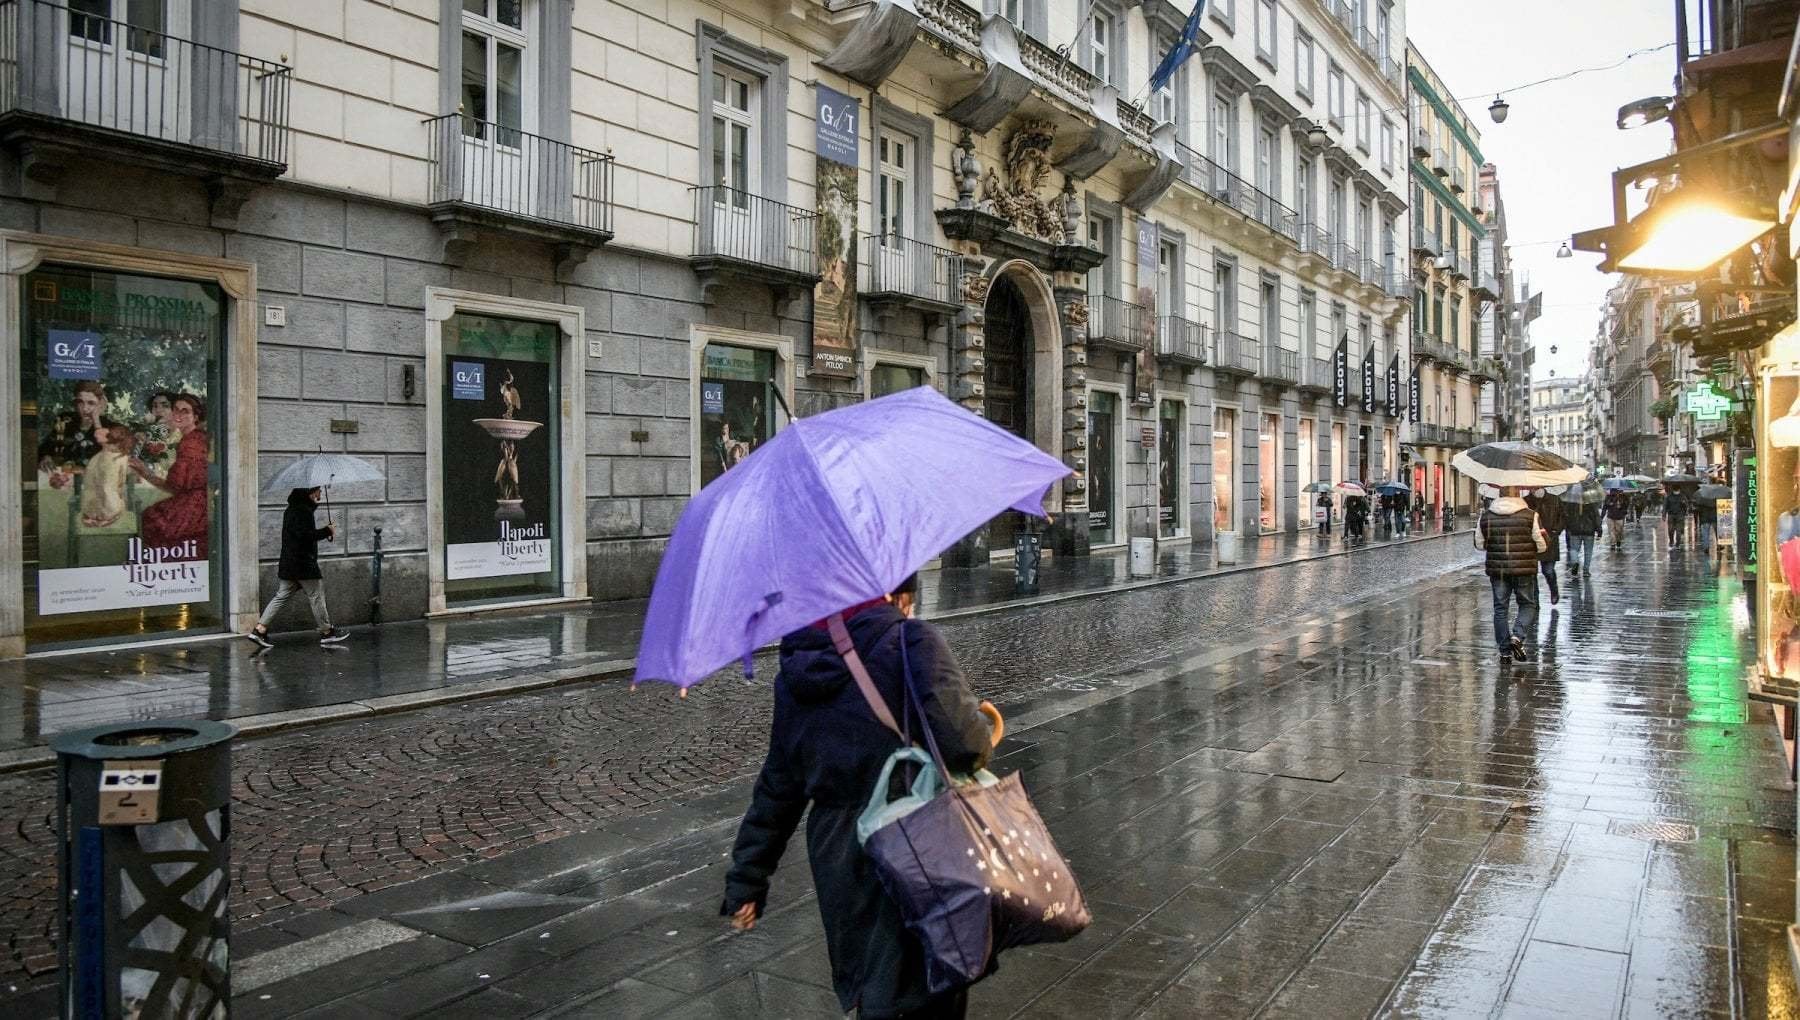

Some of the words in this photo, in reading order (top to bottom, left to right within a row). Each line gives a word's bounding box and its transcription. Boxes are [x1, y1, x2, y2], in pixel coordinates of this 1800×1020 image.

[125, 293, 206, 311] PROSSIMA
[816, 352, 834, 360] ANTON
[1337, 350, 1345, 407] ALCOTT
[1747, 470, 1757, 560] PROFUMERIA
[501, 520, 544, 541] Napoli
[127, 536, 198, 564] Napoli
